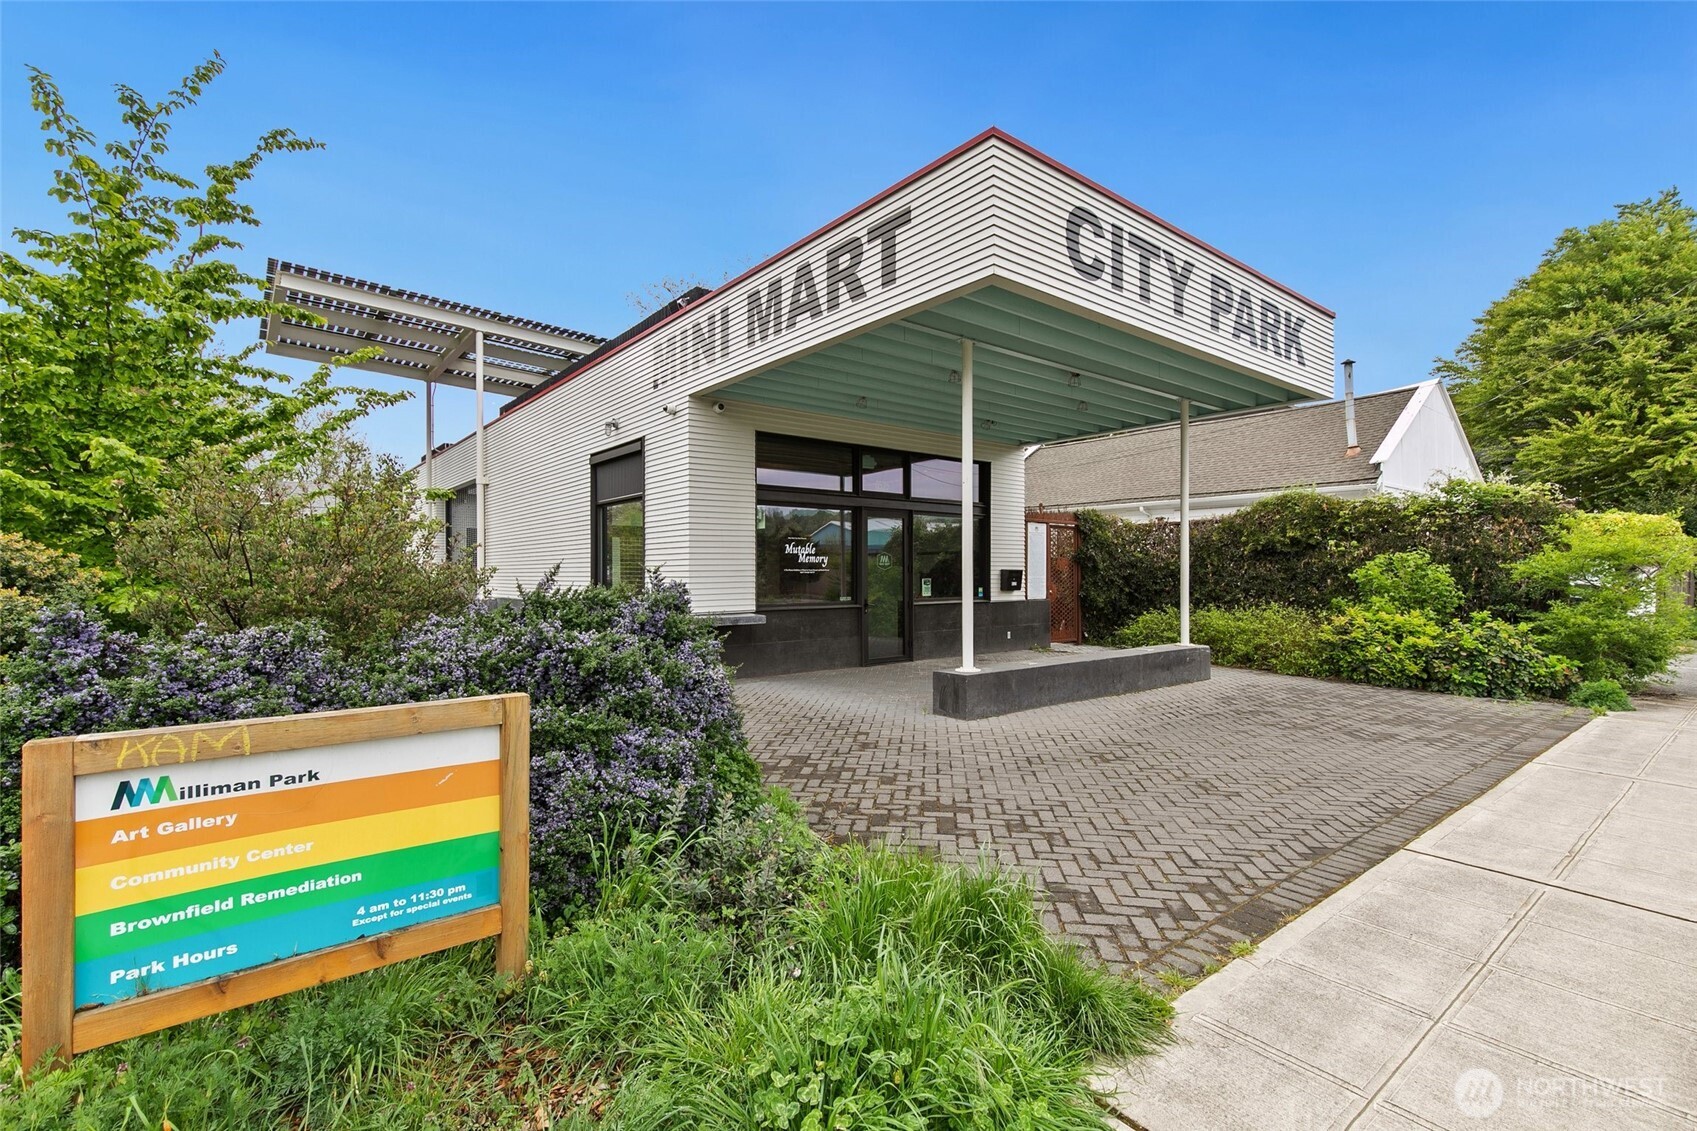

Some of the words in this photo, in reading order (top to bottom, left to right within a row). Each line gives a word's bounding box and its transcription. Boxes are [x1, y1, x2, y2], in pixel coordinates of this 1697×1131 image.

[653, 305, 729, 389] MINI
[747, 205, 911, 348] MART
[1066, 206, 1195, 318] CITY
[1210, 273, 1306, 367] PARK
[784, 542, 816, 554] Mutable
[798, 553, 828, 567] Memory
[269, 770, 320, 787] Park
[110, 825, 149, 844] Art
[157, 813, 238, 835] Gallery
[110, 855, 240, 890] Community
[246, 841, 314, 862] Center
[110, 897, 234, 937] Brownfield
[240, 872, 362, 906] Remediation
[352, 912, 388, 927] Except
[390, 908, 404, 917] for
[406, 900, 440, 914] special
[442, 892, 472, 904] events
[356, 906, 365, 915] 4
[369, 902, 389, 913] am
[393, 898, 407, 907] to
[410, 888, 444, 903] 11:30
[447, 884, 466, 896] pm
[110, 960, 166, 985] Park
[172, 943, 238, 968] Hours
